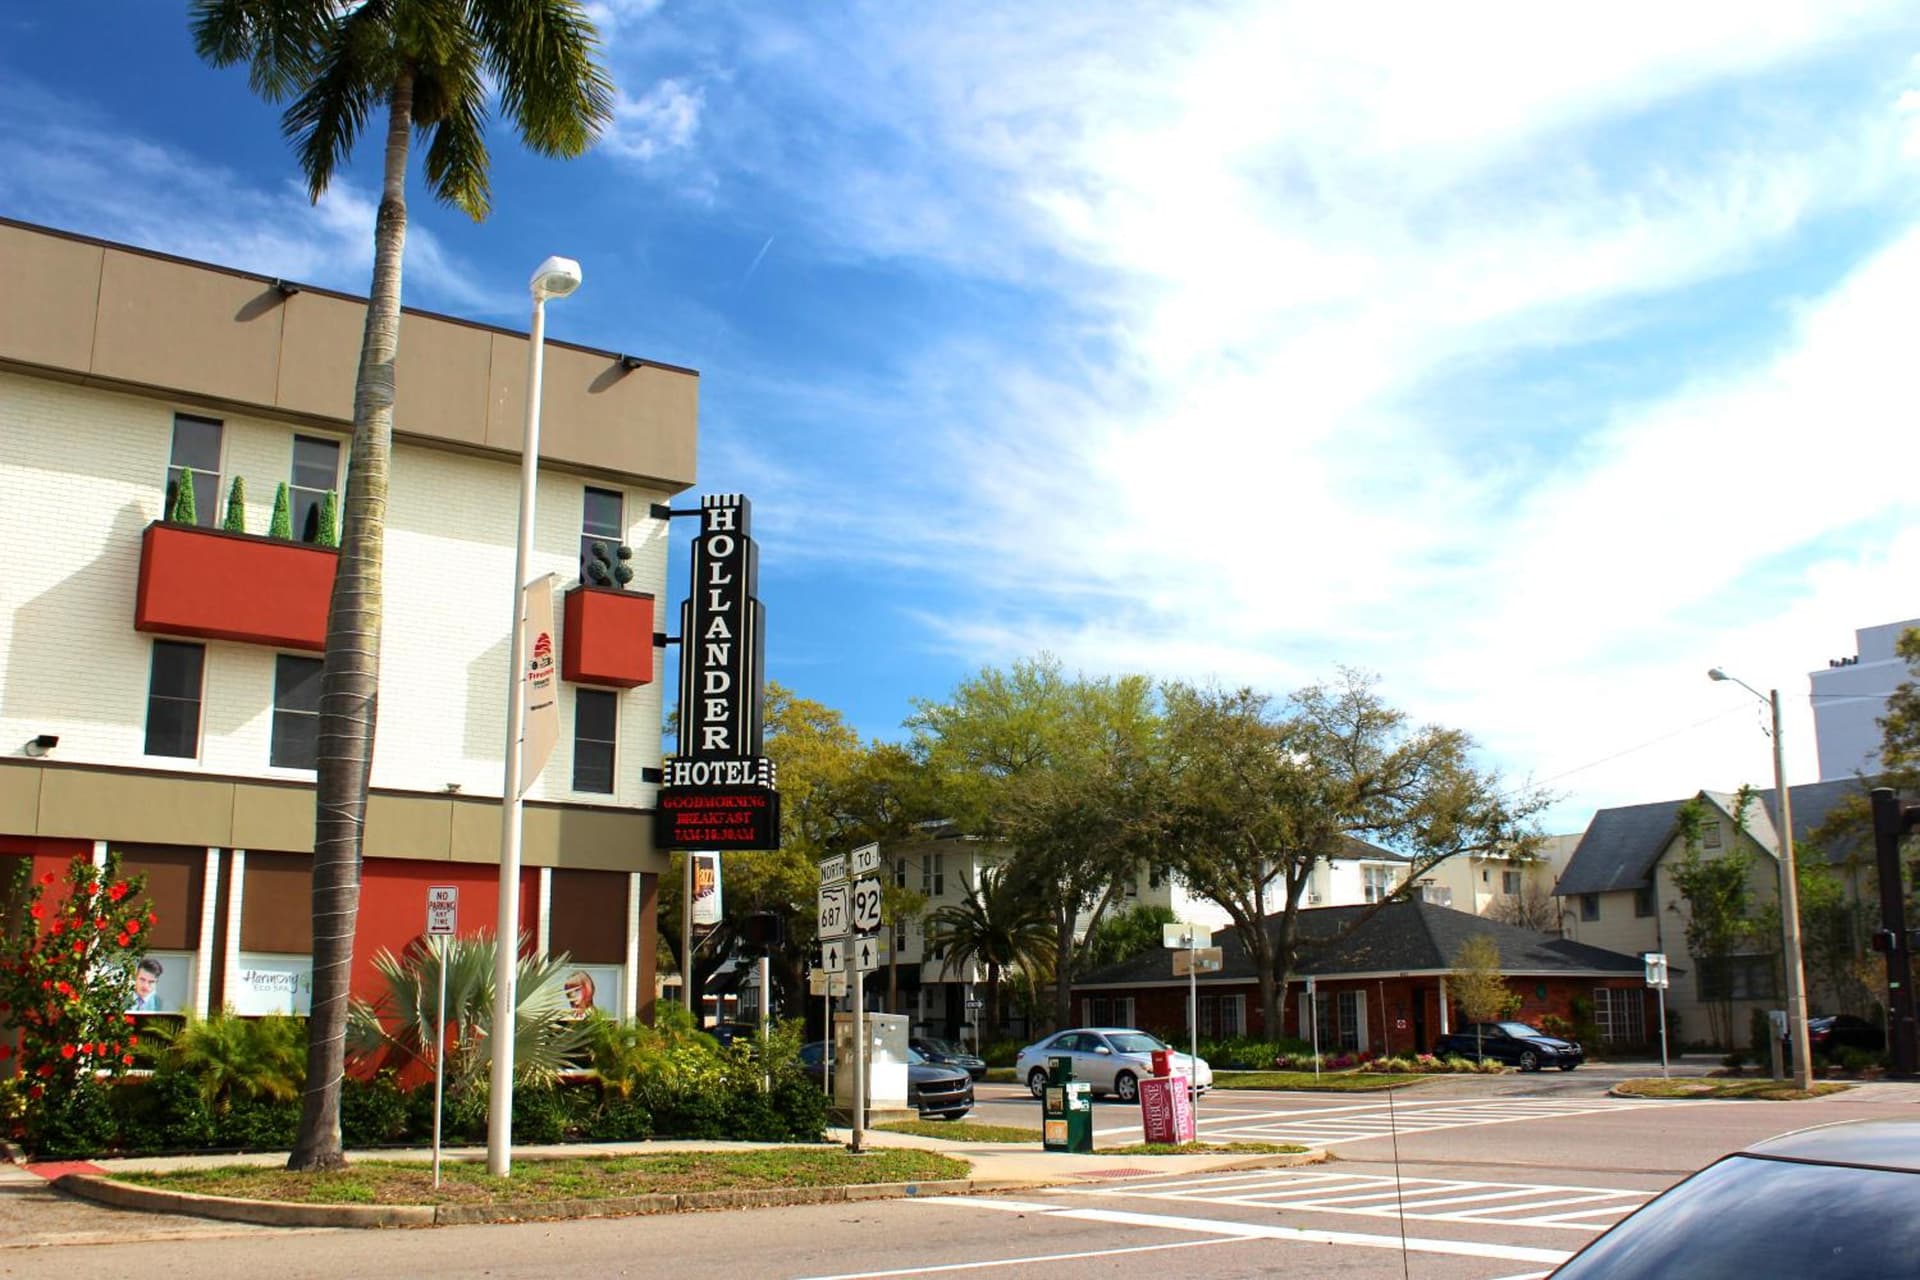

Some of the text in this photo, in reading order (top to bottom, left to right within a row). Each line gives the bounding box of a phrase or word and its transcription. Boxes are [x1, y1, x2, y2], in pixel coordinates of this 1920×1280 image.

[702, 508, 735, 750] HOLLANDER
[673, 761, 756, 785] HOTEL
[858, 851, 872, 867] TO
[821, 862, 845, 881] NORTH
[430, 901, 455, 911] PARKING
[436, 891, 448, 900] NO
[856, 890, 879, 920] 92
[821, 907, 841, 928] 687
[243, 970, 299, 994] Harmony
[1149, 1084, 1164, 1137] TRIBUNE
